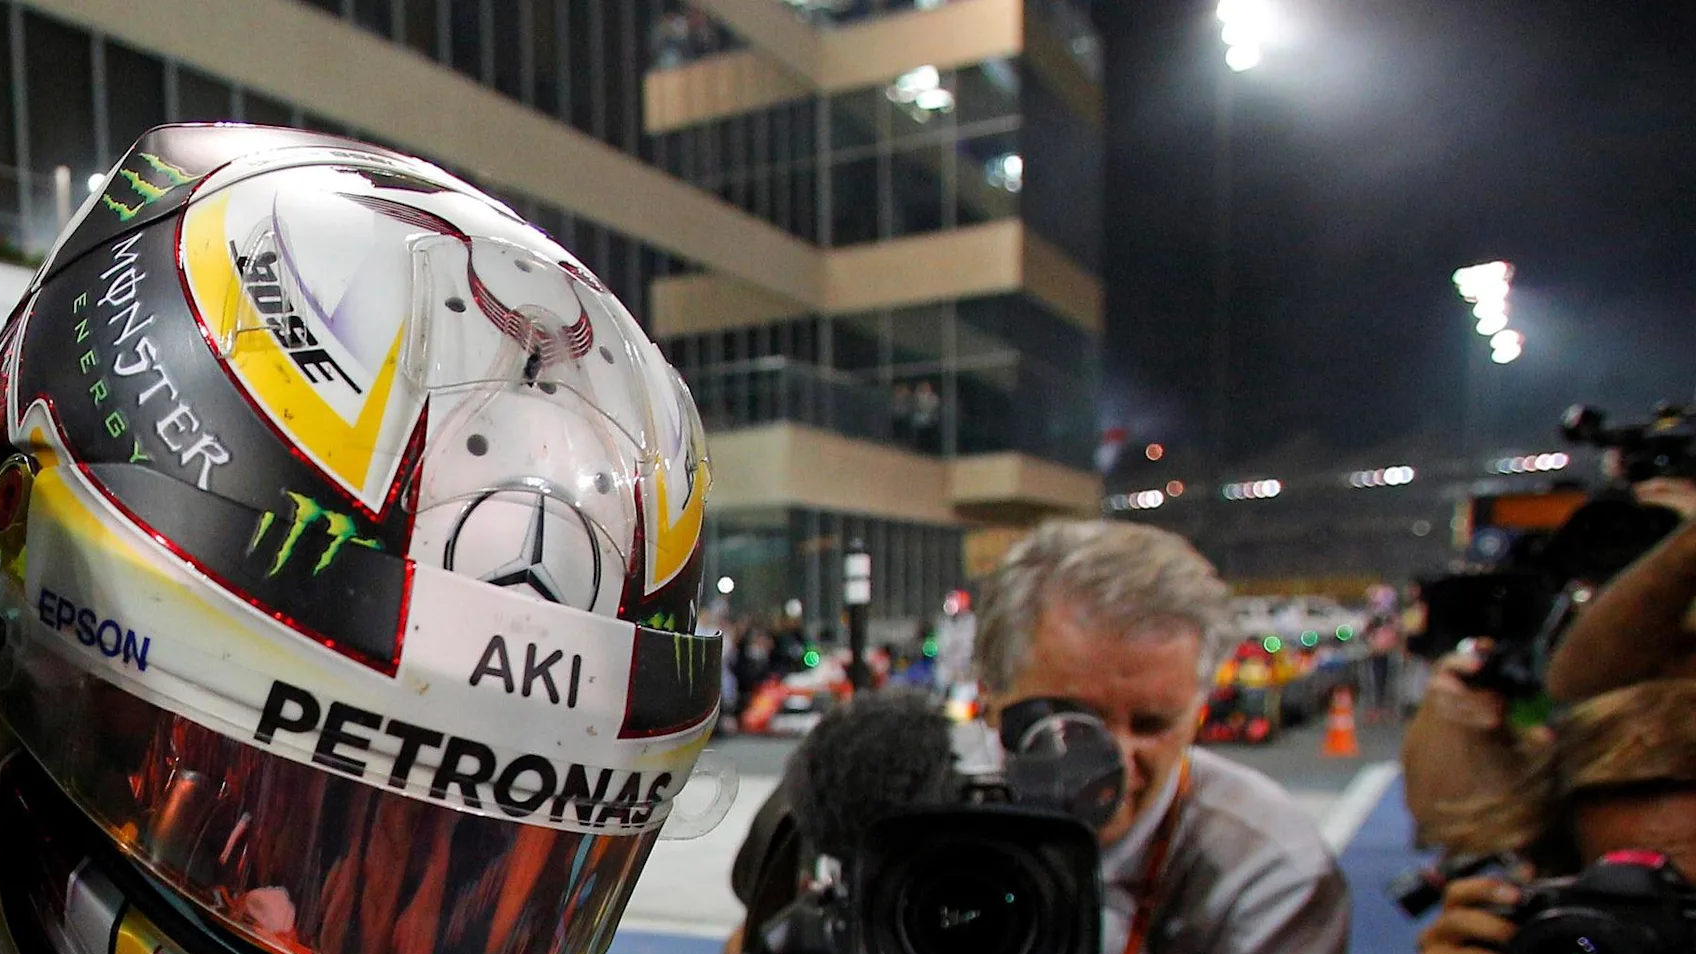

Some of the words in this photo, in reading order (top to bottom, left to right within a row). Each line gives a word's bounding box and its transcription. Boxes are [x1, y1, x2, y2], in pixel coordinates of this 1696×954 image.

[73, 292, 150, 464] ENERGY
[96, 231, 231, 491] MONSTER
[38, 587, 151, 672] EPSON
[468, 634, 583, 709] AKI
[253, 679, 674, 829] PETRONAS
